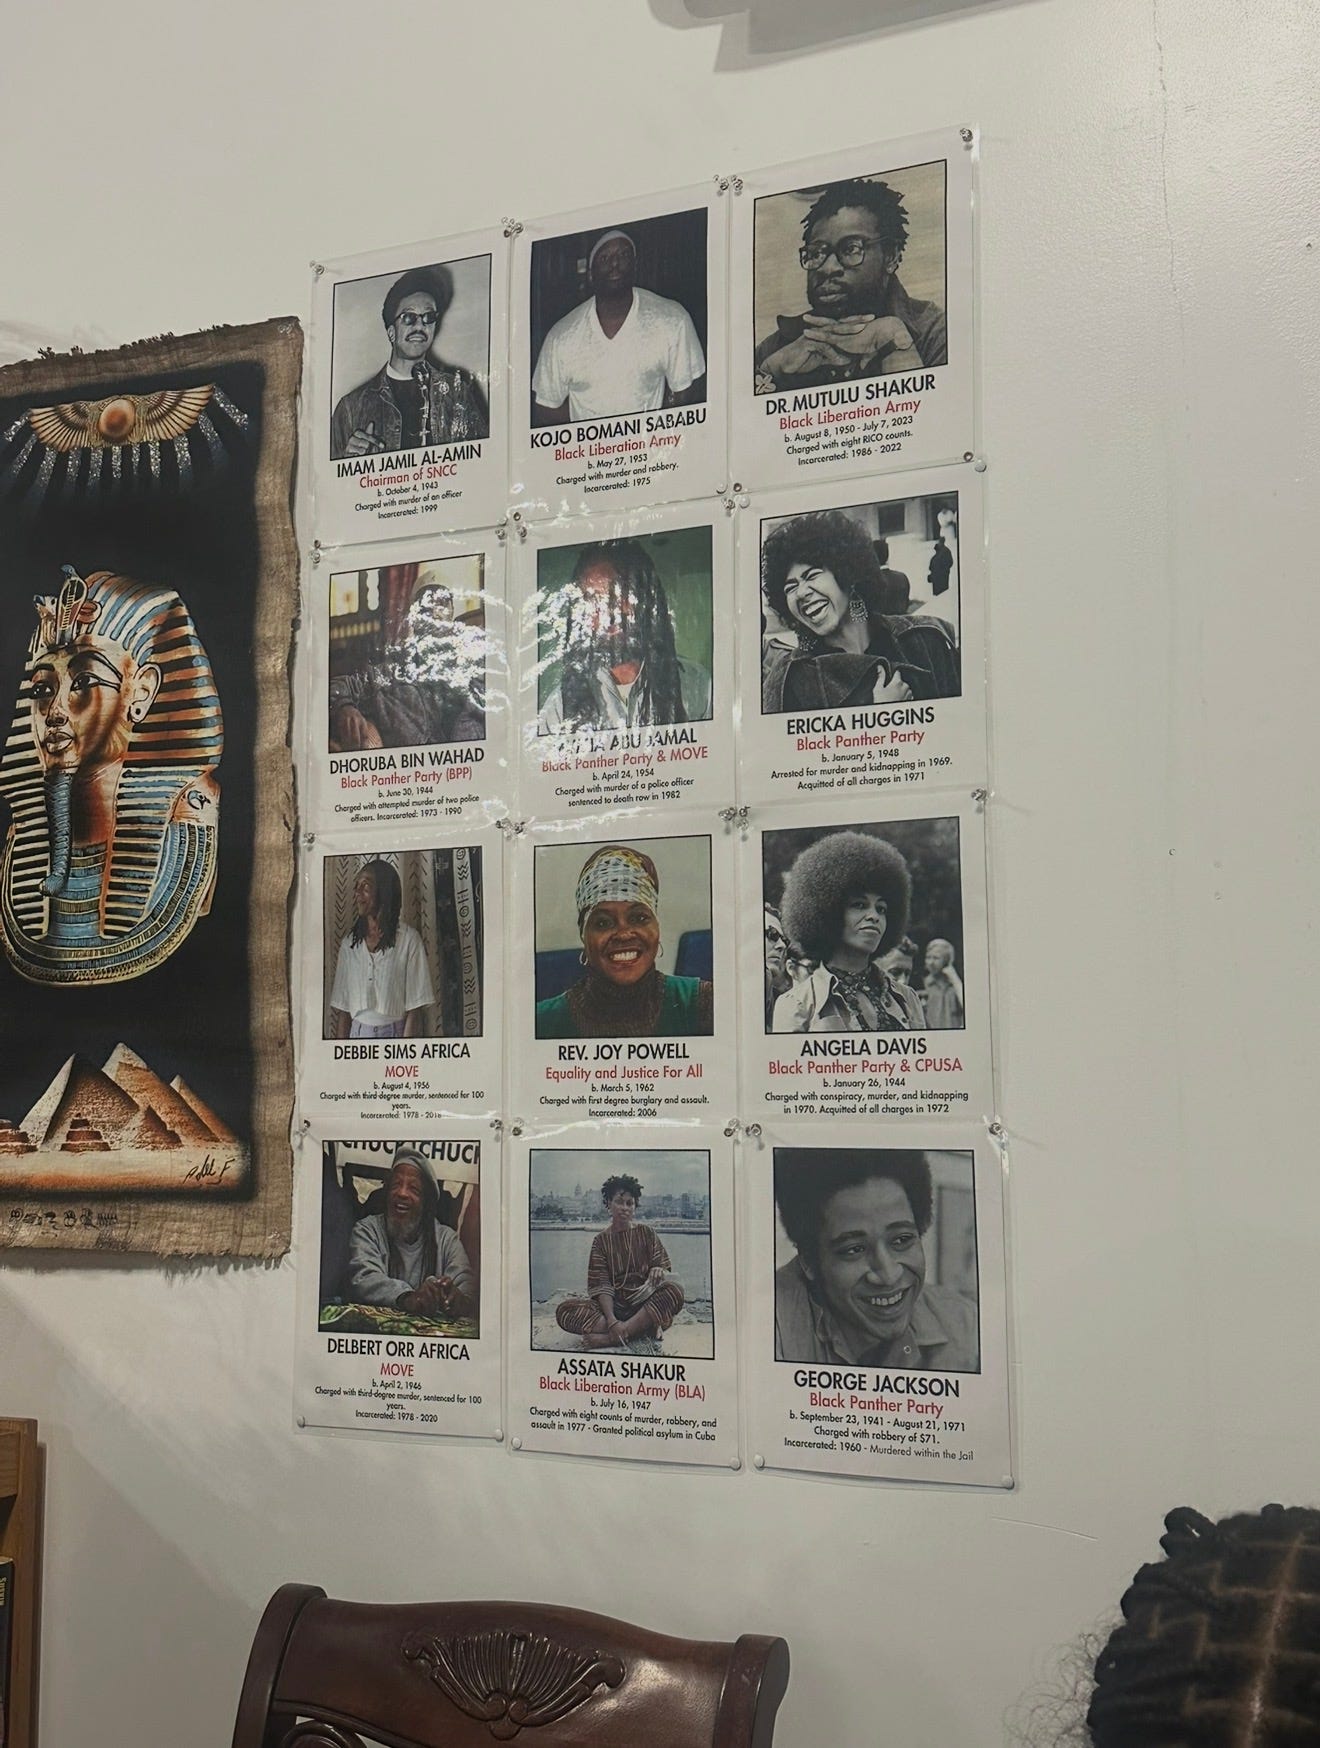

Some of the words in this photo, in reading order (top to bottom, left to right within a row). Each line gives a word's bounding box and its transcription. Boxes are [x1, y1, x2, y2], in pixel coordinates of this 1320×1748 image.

[766, 397, 790, 415] DR.
[793, 386, 859, 411] MUTULU
[866, 374, 935, 400] SHAKUR
[780, 413, 812, 430] Black
[817, 406, 880, 424] Liberation
[885, 400, 921, 414] Army
[530, 428, 572, 448] KOJO
[577, 418, 641, 442] BOMANI
[646, 408, 706, 432] SABABU
[555, 445, 585, 461] Black
[589, 439, 645, 456] Liberation
[650, 435, 680, 448] Army
[786, 442, 820, 455] Charged
[822, 439, 839, 449] with
[841, 436, 861, 447] eight
[862, 432, 884, 443] RICO
[885, 430, 913, 440] counts.
[337, 458, 375, 478] IMAM
[379, 453, 417, 472] JAMIL
[421, 443, 481, 466] AL-AMIN
[596, 459, 613, 469] May
[615, 457, 626, 466] 27,
[630, 453, 648, 463] 1953
[360, 474, 410, 488] Chairman
[413, 469, 423, 481] of
[427, 464, 457, 479] SNCC
[556, 473, 587, 485] Charged
[588, 471, 604, 480] with
[605, 468, 631, 478] murder
[633, 465, 647, 474] and
[648, 462, 679, 472] robbery.
[584, 479, 630, 493] Incarcerated:
[633, 476, 650, 486] 1975
[378, 507, 419, 519] Incarcerated:
[421, 504, 437, 513] 1999
[787, 715, 846, 735] ERICKA
[852, 707, 934, 730] HUGGINS
[797, 736, 830, 751] Black
[835, 733, 886, 748] Panther
[890, 730, 924, 744] Party
[330, 755, 396, 774] DHORUBA
[401, 753, 425, 768] BIN
[428, 748, 484, 766] WAHAD
[575, 755, 619, 769] Panther
[623, 753, 653, 766] Party
[657, 750, 666, 762] &
[670, 747, 708, 761] MOVE
[832, 753, 865, 762] January
[879, 748, 899, 758] 1948
[341, 776, 368, 788] Black
[371, 773, 411, 786] Panther
[414, 772, 442, 784] Party
[446, 767, 472, 782] (BPP)
[797, 779, 835, 791] Acquitted
[847, 777, 858, 786] all
[859, 776, 891, 786] charges
[905, 772, 925, 782] 1971
[386, 789, 401, 797] June
[402, 787, 413, 796] 30,
[416, 786, 433, 794] 1944
[568, 796, 603, 807] sentenced
[613, 794, 634, 803] death
[662, 790, 680, 800] 1982
[334, 1045, 379, 1060] DEBBIE
[384, 1044, 417, 1059] SIMS
[421, 1043, 470, 1059] AFRICA
[558, 1045, 588, 1061] REV.
[594, 1044, 622, 1060] JOY
[627, 1043, 689, 1060] POWELL
[801, 1039, 871, 1057] ANGELA
[877, 1038, 927, 1055] DAVIS
[385, 1065, 419, 1078] MOVE
[546, 1066, 591, 1082] Equality
[595, 1066, 617, 1079] and
[621, 1066, 659, 1078] Justice
[663, 1065, 682, 1078] For
[686, 1065, 702, 1078] All
[769, 1061, 803, 1074] Black
[807, 1060, 856, 1074] Panther
[861, 1060, 895, 1076] Party
[900, 1059, 910, 1072] &
[915, 1058, 962, 1072] CPUSA
[600, 1084, 624, 1092] March
[636, 1083, 654, 1091] 1962
[833, 1079, 866, 1089] January
[868, 1078, 882, 1088] 26,
[885, 1078, 905, 1087] 1944
[589, 1109, 636, 1117] Incarcerated:
[637, 1109, 657, 1117] 2006
[794, 1105, 816, 1114] 1970.
[819, 1105, 857, 1116] Acquitted
[869, 1105, 880, 1113] all
[881, 1105, 914, 1115] charges
[927, 1104, 949, 1113] 1972
[327, 1338, 382, 1356] DELBERT
[386, 1341, 414, 1358] ORR
[419, 1343, 470, 1361] AFRICA
[380, 1363, 414, 1377] MOVE
[558, 1358, 615, 1377] ASSATA
[621, 1361, 685, 1381] SHAKUR
[380, 1380, 396, 1390] April
[405, 1381, 421, 1390] 1946
[539, 1377, 570, 1391] Black
[574, 1378, 632, 1394] Liberation
[637, 1382, 670, 1400] Army
[675, 1383, 705, 1400] (BLA)
[794, 1370, 867, 1392] GEORGE
[873, 1375, 959, 1397] JACKSON
[600, 1399, 615, 1410] July
[617, 1400, 629, 1409] 16,
[632, 1400, 651, 1410] 1947
[810, 1392, 845, 1408] Black
[850, 1395, 902, 1412] Panther
[907, 1399, 943, 1418] Party
[530, 1407, 561, 1419] Charged
[562, 1410, 578, 1418] with
[579, 1411, 598, 1421] eight
[599, 1413, 623, 1421] counts
[634, 1415, 664, 1425] murder,
[666, 1416, 699, 1428] robbery,
[701, 1419, 717, 1427] and
[814, 1425, 850, 1439] Charged
[851, 1429, 870, 1439] with
[872, 1431, 906, 1444] robbery
[920, 1434, 940, 1444] $71.
